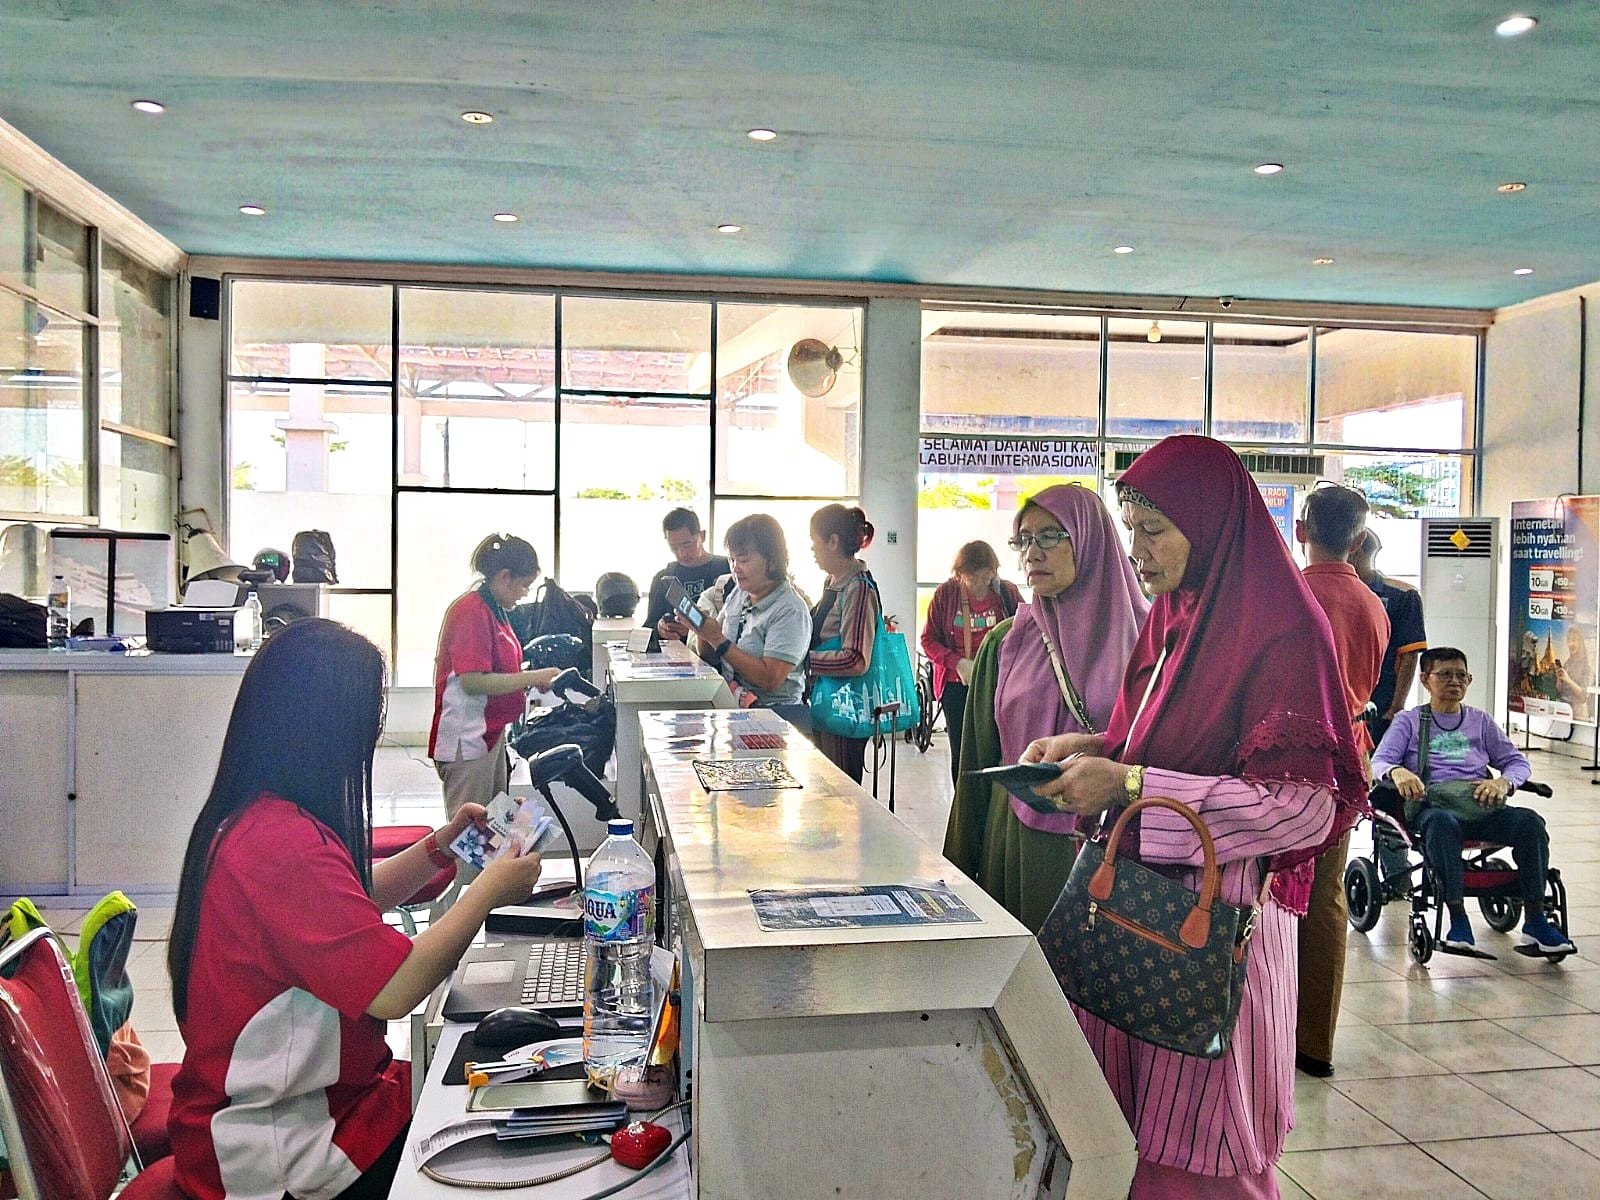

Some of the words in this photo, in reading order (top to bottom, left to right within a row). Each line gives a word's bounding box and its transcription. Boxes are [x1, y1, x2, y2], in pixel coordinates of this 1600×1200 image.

[924, 439, 989, 451] SELAMAT
[994, 440, 1049, 452] DATANG
[1053, 441, 1067, 453] DI
[1513, 532, 1536, 545] lebih
[1513, 548, 1533, 559] saat
[1534, 546, 1584, 560] travelling!
[585, 896, 617, 921] QUA
